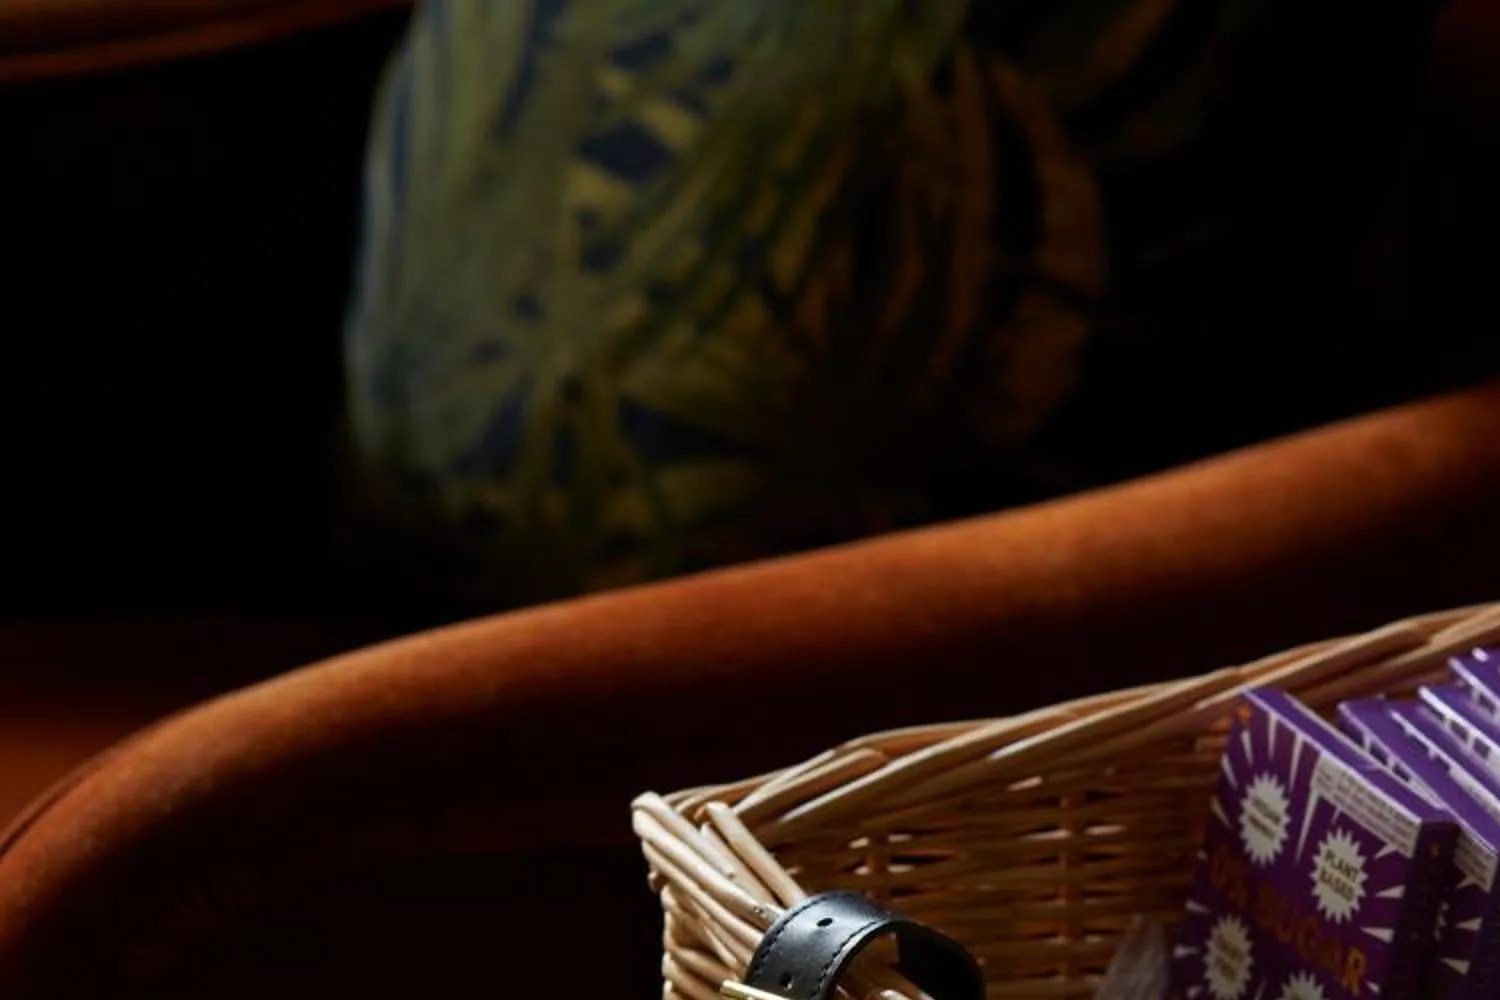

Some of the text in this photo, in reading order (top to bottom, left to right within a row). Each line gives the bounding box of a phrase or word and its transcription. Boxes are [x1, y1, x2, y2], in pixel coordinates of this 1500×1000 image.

[1325, 849, 1359, 882] PLANT
[1319, 867, 1355, 901] BASED
[1256, 880, 1367, 998] SUGAR
